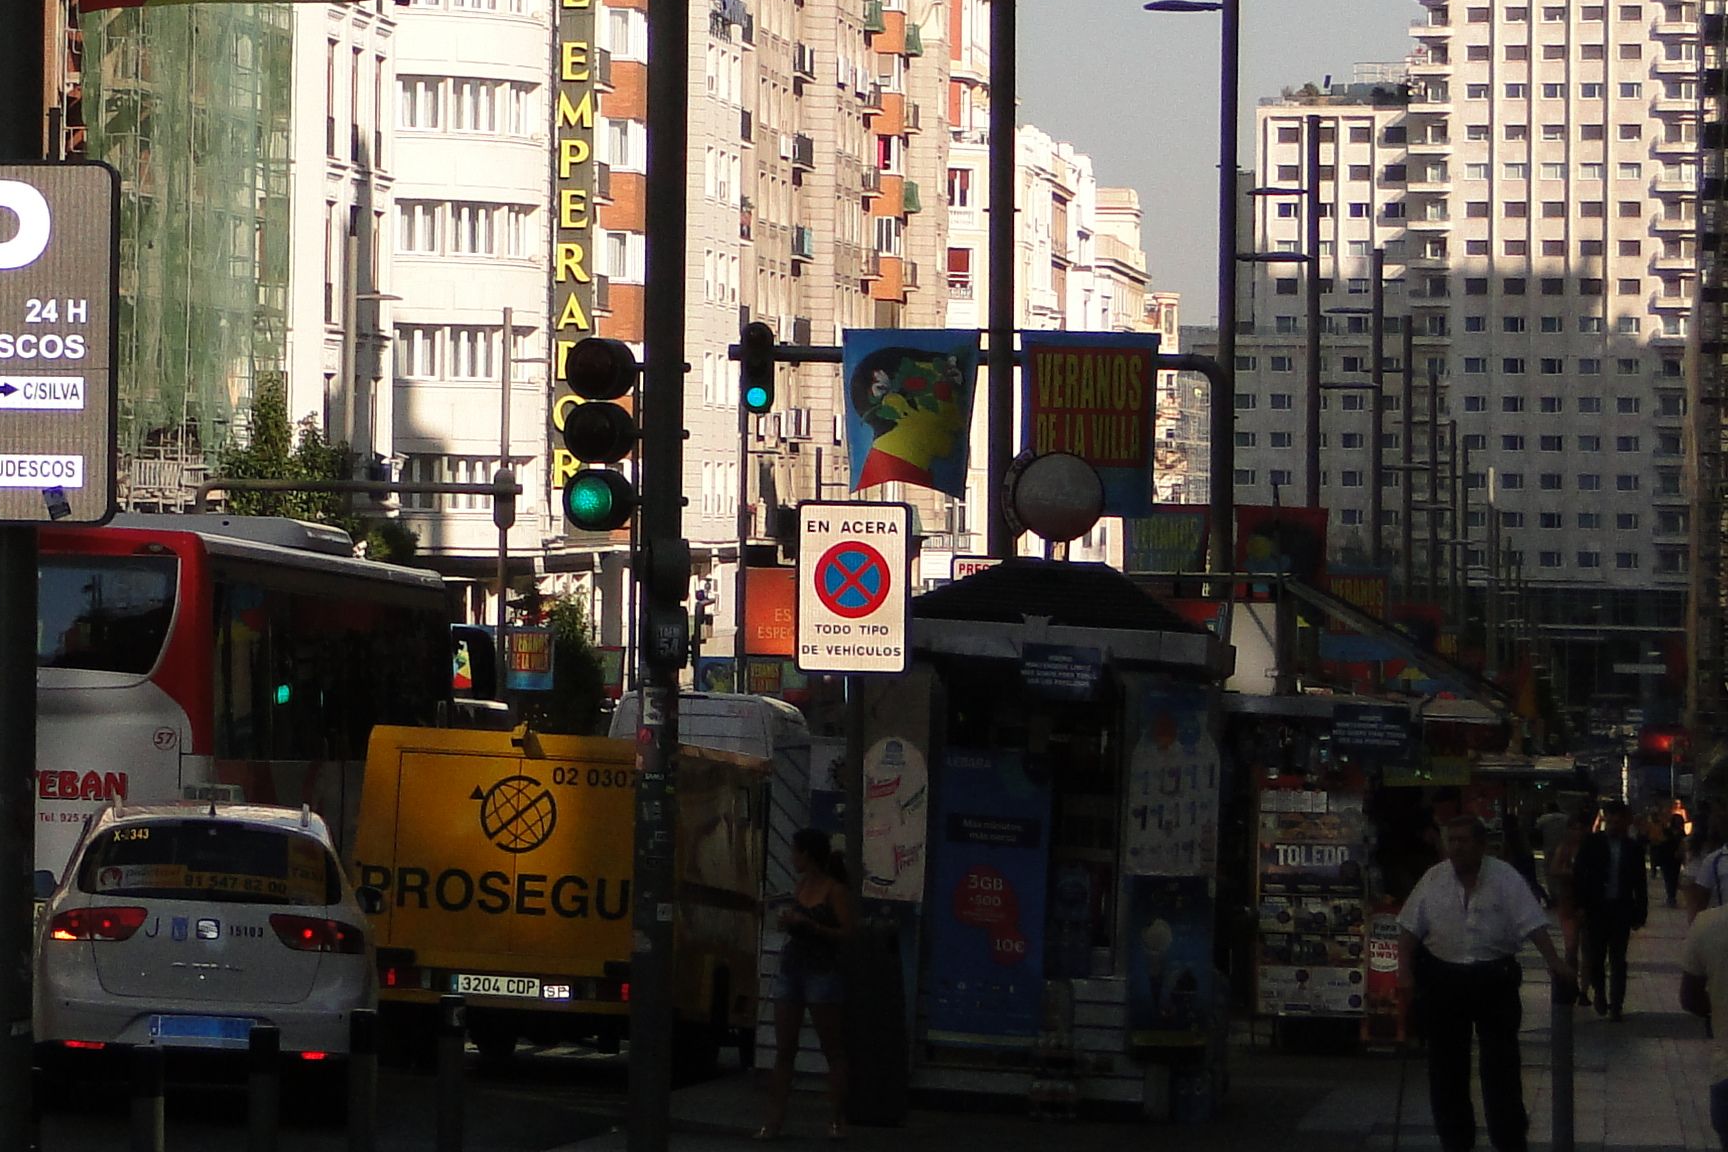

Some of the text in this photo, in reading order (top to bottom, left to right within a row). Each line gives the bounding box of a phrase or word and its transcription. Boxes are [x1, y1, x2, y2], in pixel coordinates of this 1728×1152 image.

[25, 298, 87, 324] 24 H
[23, 381, 81, 401] C/SILVA
[1035, 352, 1144, 412] VERANOS
[1091, 414, 1143, 461] VILLA
[807, 521, 900, 535] EN ACERA
[815, 624, 889, 636] TODO TIPO
[801, 643, 903, 657] DE VEHÍCULOS
[156, 731, 174, 745] 57
[552, 767, 579, 786] 02
[461, 975, 502, 994] 3204
[546, 985, 570, 998] SP
